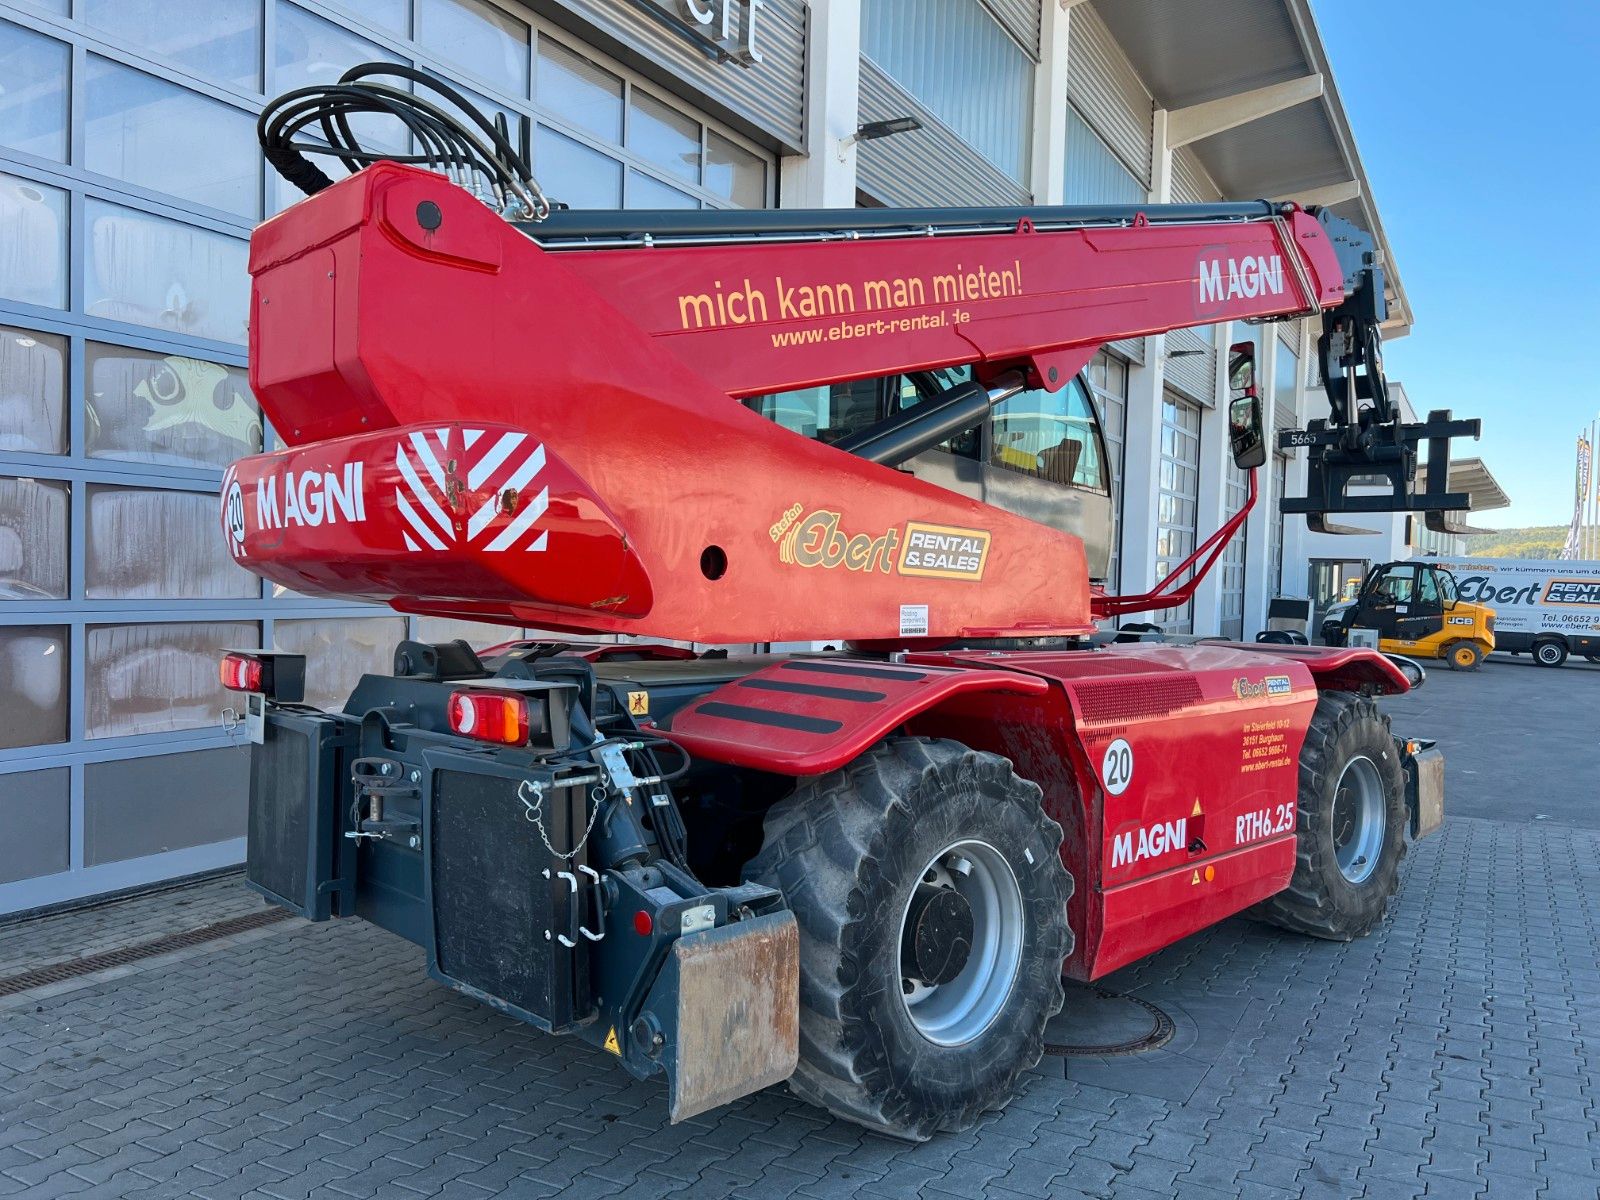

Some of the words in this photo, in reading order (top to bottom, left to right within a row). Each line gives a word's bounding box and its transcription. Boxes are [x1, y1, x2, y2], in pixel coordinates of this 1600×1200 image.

[678, 279, 768, 329] mich
[775, 276, 855, 319] kann
[863, 277, 925, 311] man
[932, 259, 1023, 303] mieten!
[1199, 255, 1284, 304] MAGNI
[229, 490, 243, 533] 20
[256, 461, 367, 530] MAGNI
[769, 502, 804, 543] Stefan
[793, 509, 900, 574] Ebert
[905, 551, 921, 567] &
[923, 553, 980, 571] SALES
[909, 533, 983, 554] RENTAL
[1457, 576, 1541, 605] Ebert
[1547, 594, 1558, 602] &
[1448, 617, 1473, 625] JCB
[1542, 613, 1558, 622] Tel.
[1561, 615, 1590, 623] 06652
[1107, 747, 1130, 786] 20
[1111, 818, 1187, 869] MAGNI
[1235, 802, 1295, 845] RTH6.25
